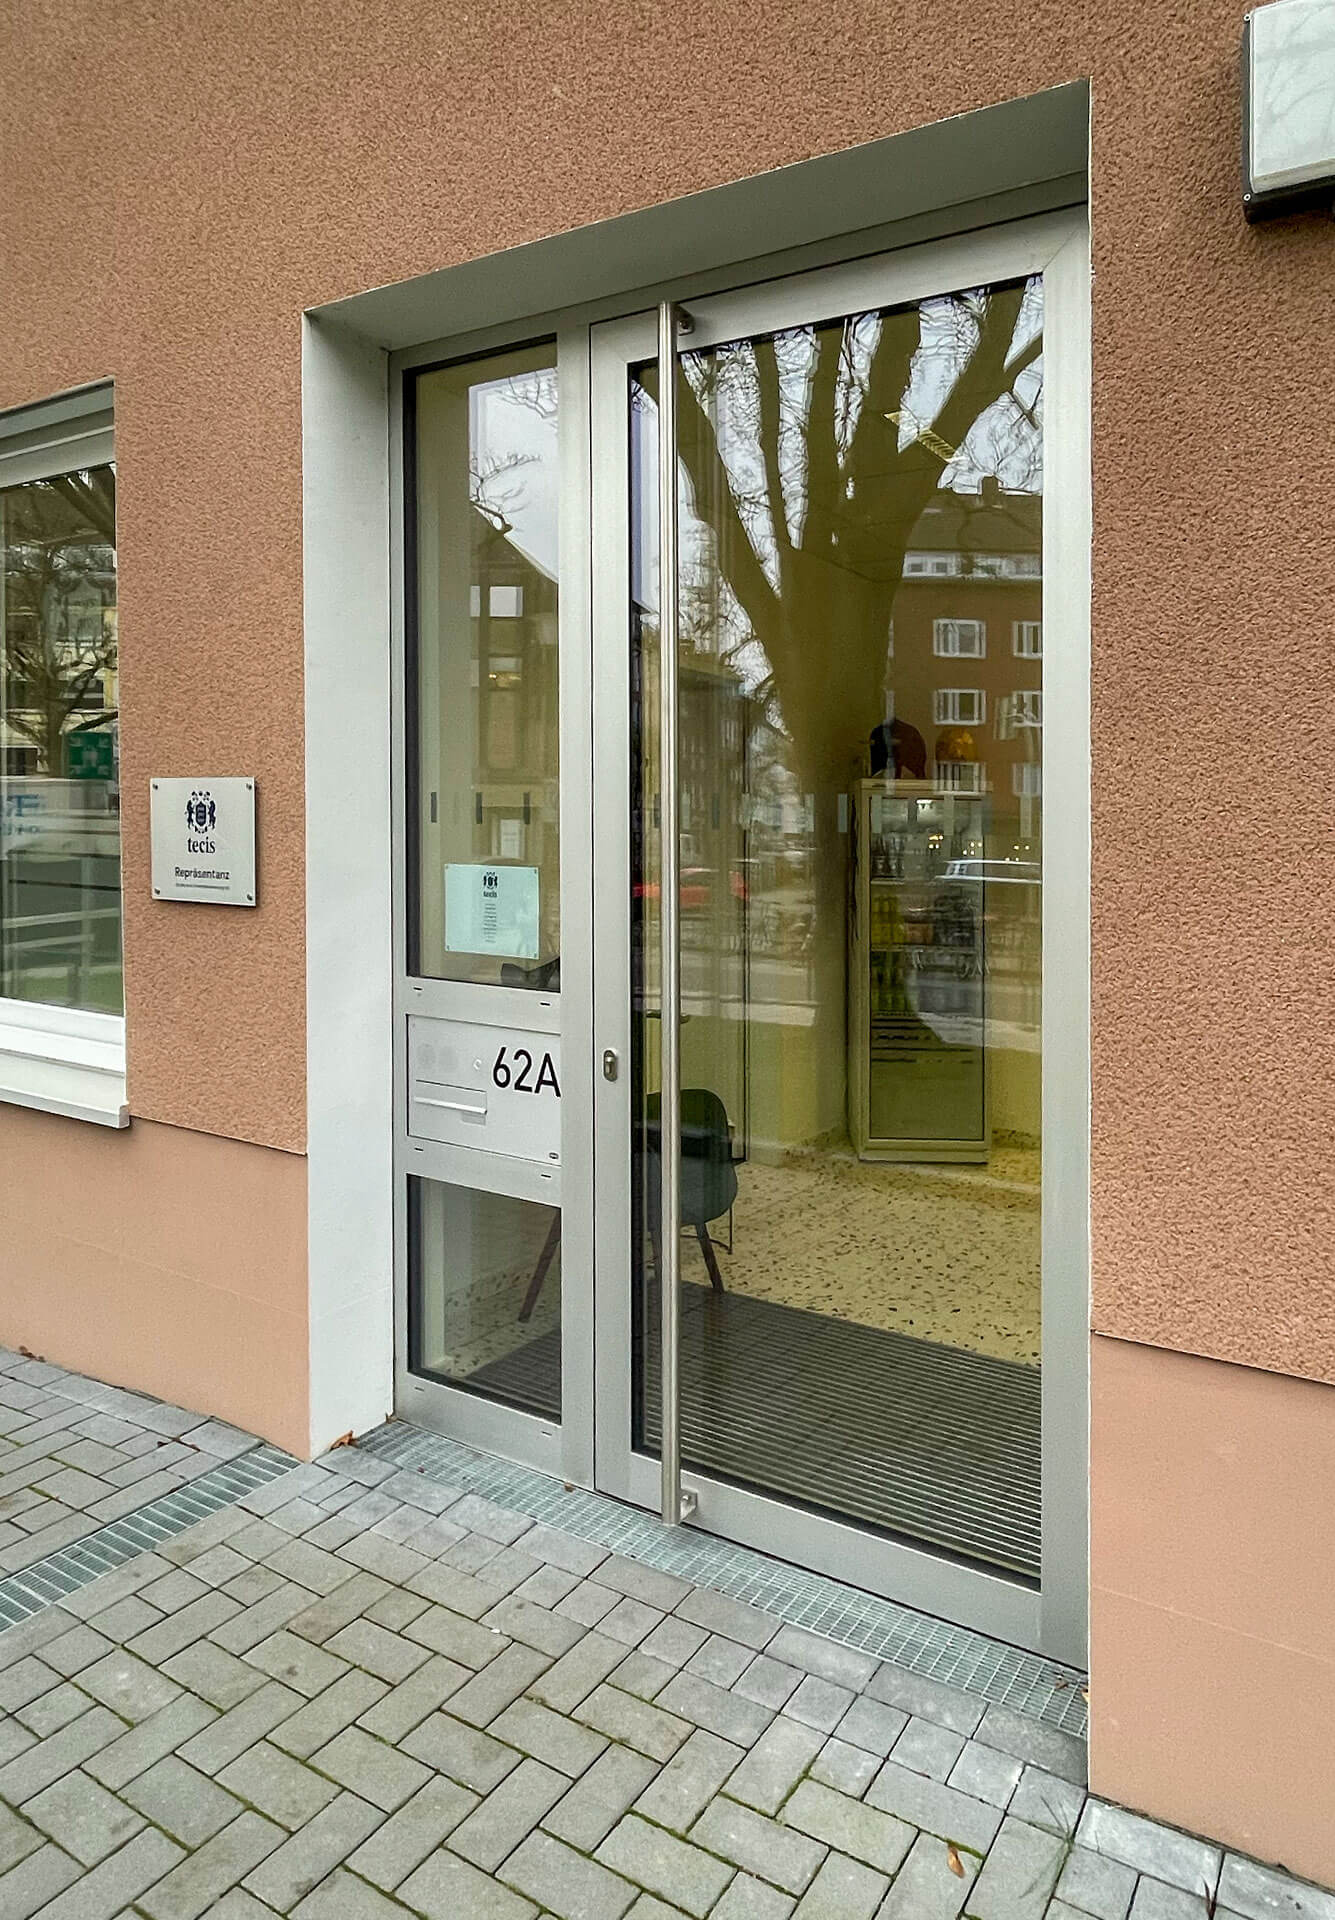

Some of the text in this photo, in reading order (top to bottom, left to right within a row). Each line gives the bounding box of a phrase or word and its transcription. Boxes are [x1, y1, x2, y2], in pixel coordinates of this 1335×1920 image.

[187, 836, 216, 854] tecis
[175, 866, 230, 880] Repräsentanz
[492, 1046, 561, 1098] 62A
